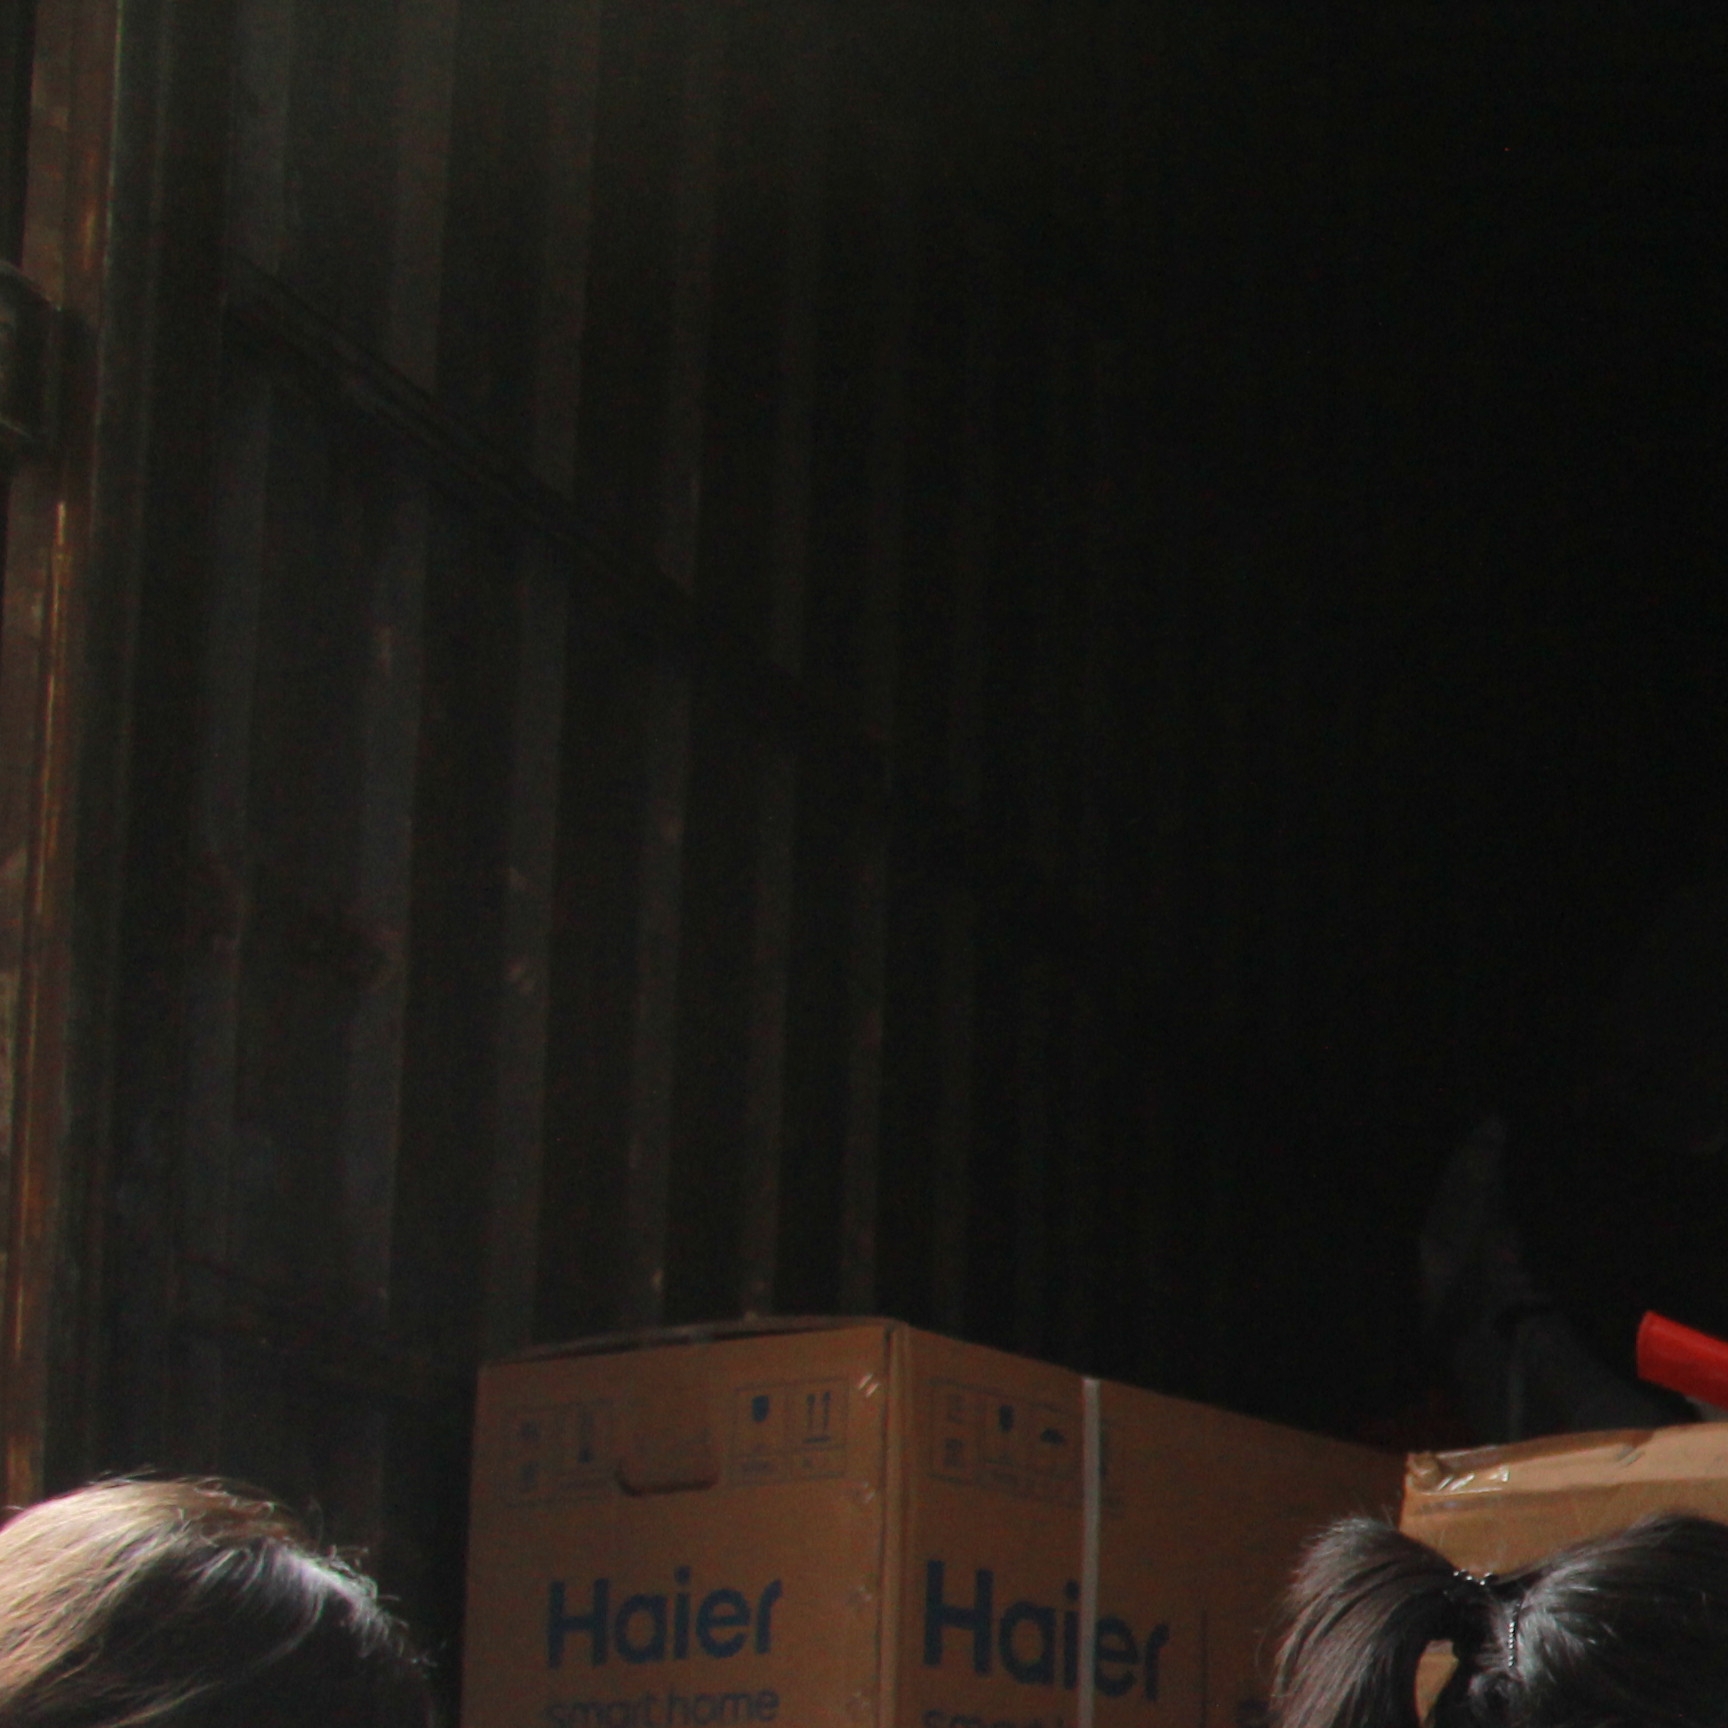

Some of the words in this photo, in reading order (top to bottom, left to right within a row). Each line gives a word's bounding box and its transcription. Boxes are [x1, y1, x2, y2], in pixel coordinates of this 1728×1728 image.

[546, 1564, 784, 1670] Haier
[922, 1558, 1170, 1702] Haier
[665, 1684, 780, 1728] home
